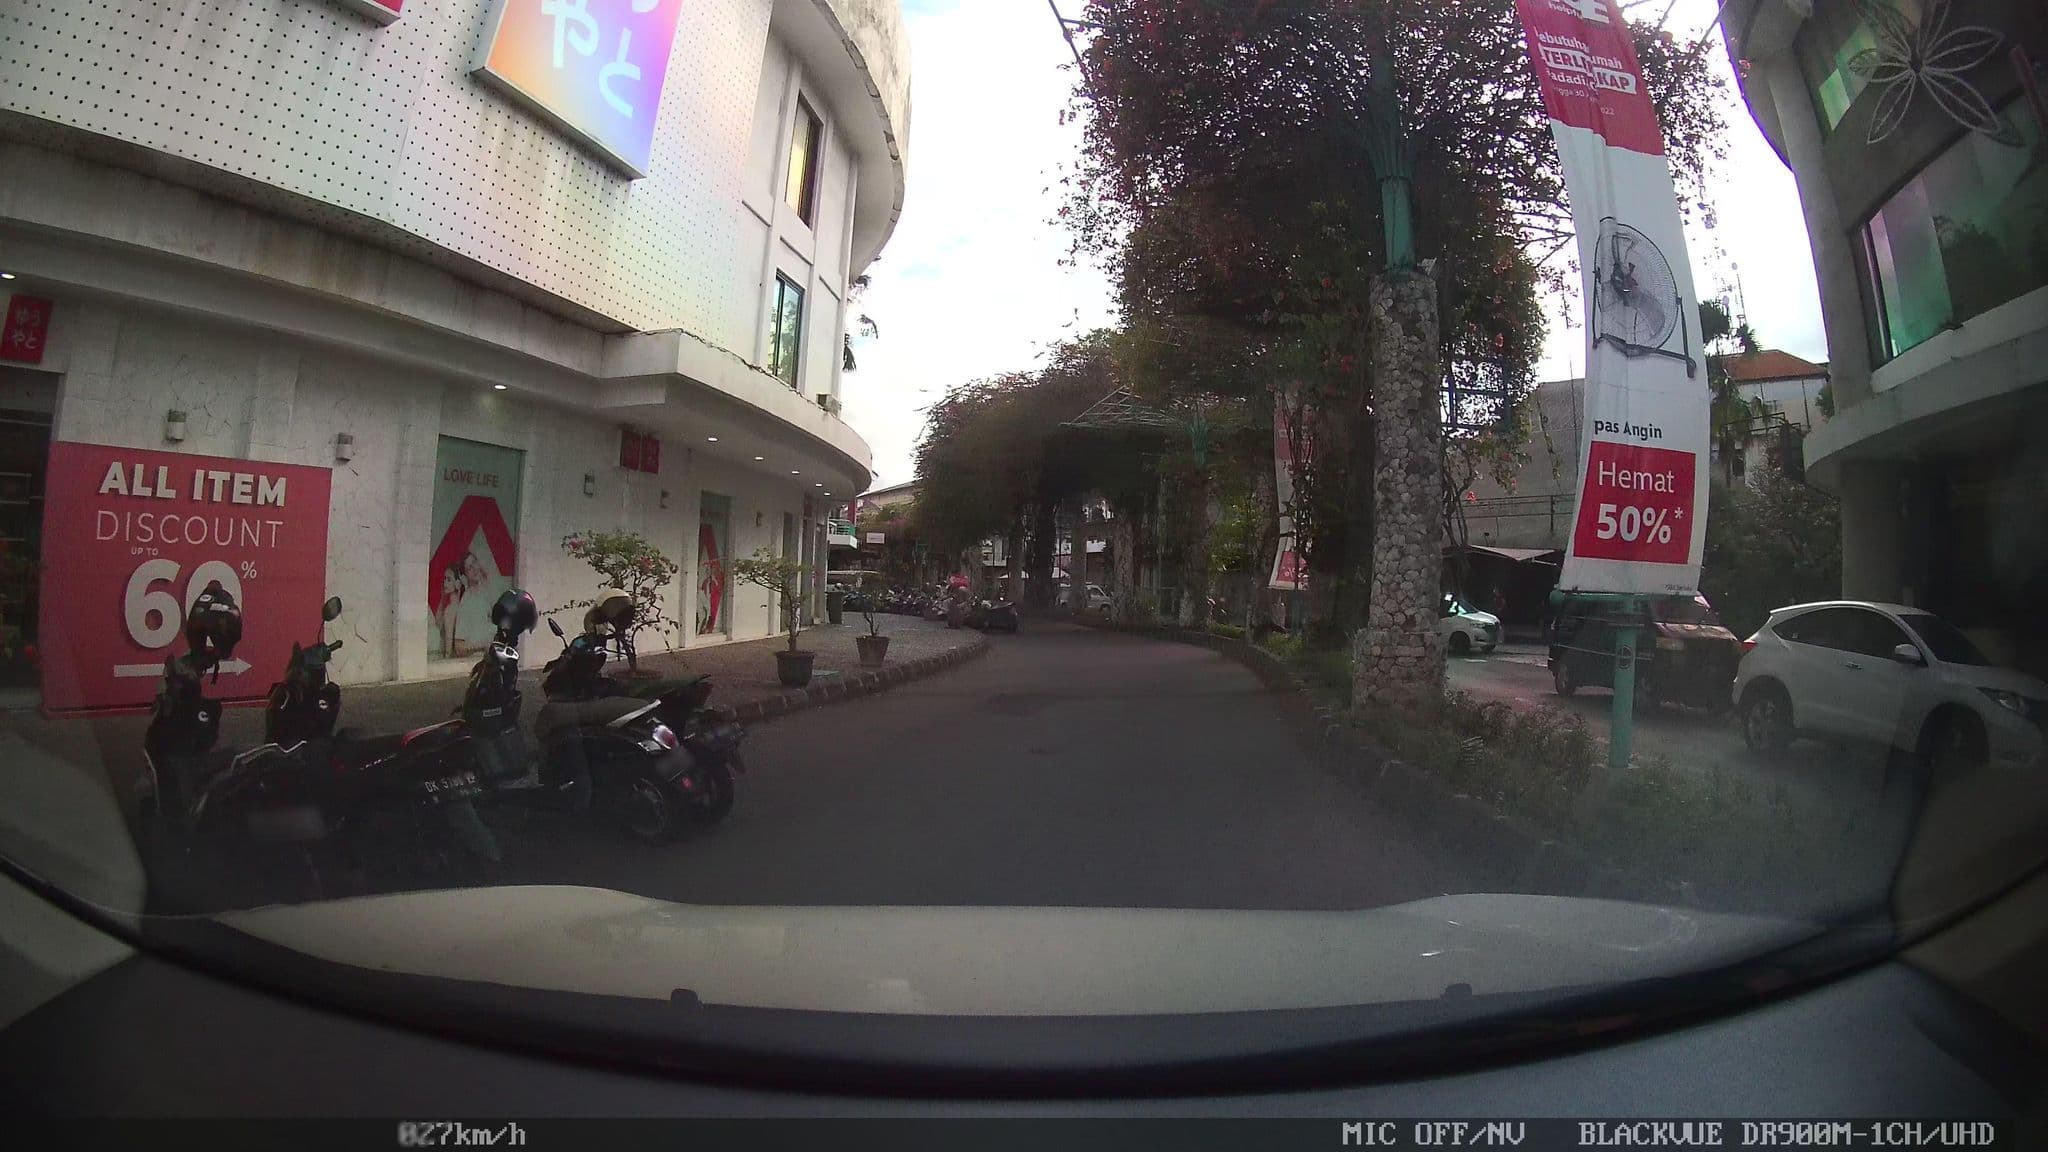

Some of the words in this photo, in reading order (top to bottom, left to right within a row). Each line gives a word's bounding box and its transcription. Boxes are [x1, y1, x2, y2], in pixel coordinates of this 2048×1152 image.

[1623, 422, 1663, 440] Angin
[98, 461, 177, 499] ALL
[192, 469, 288, 507] ITEM
[444, 468, 473, 485] LOVE
[476, 472, 499, 488] LIFE
[1598, 460, 1675, 493] Hemat
[96, 510, 284, 547] DISCOUNT
[131, 547, 144, 556] UP
[146, 547, 159, 556] TO
